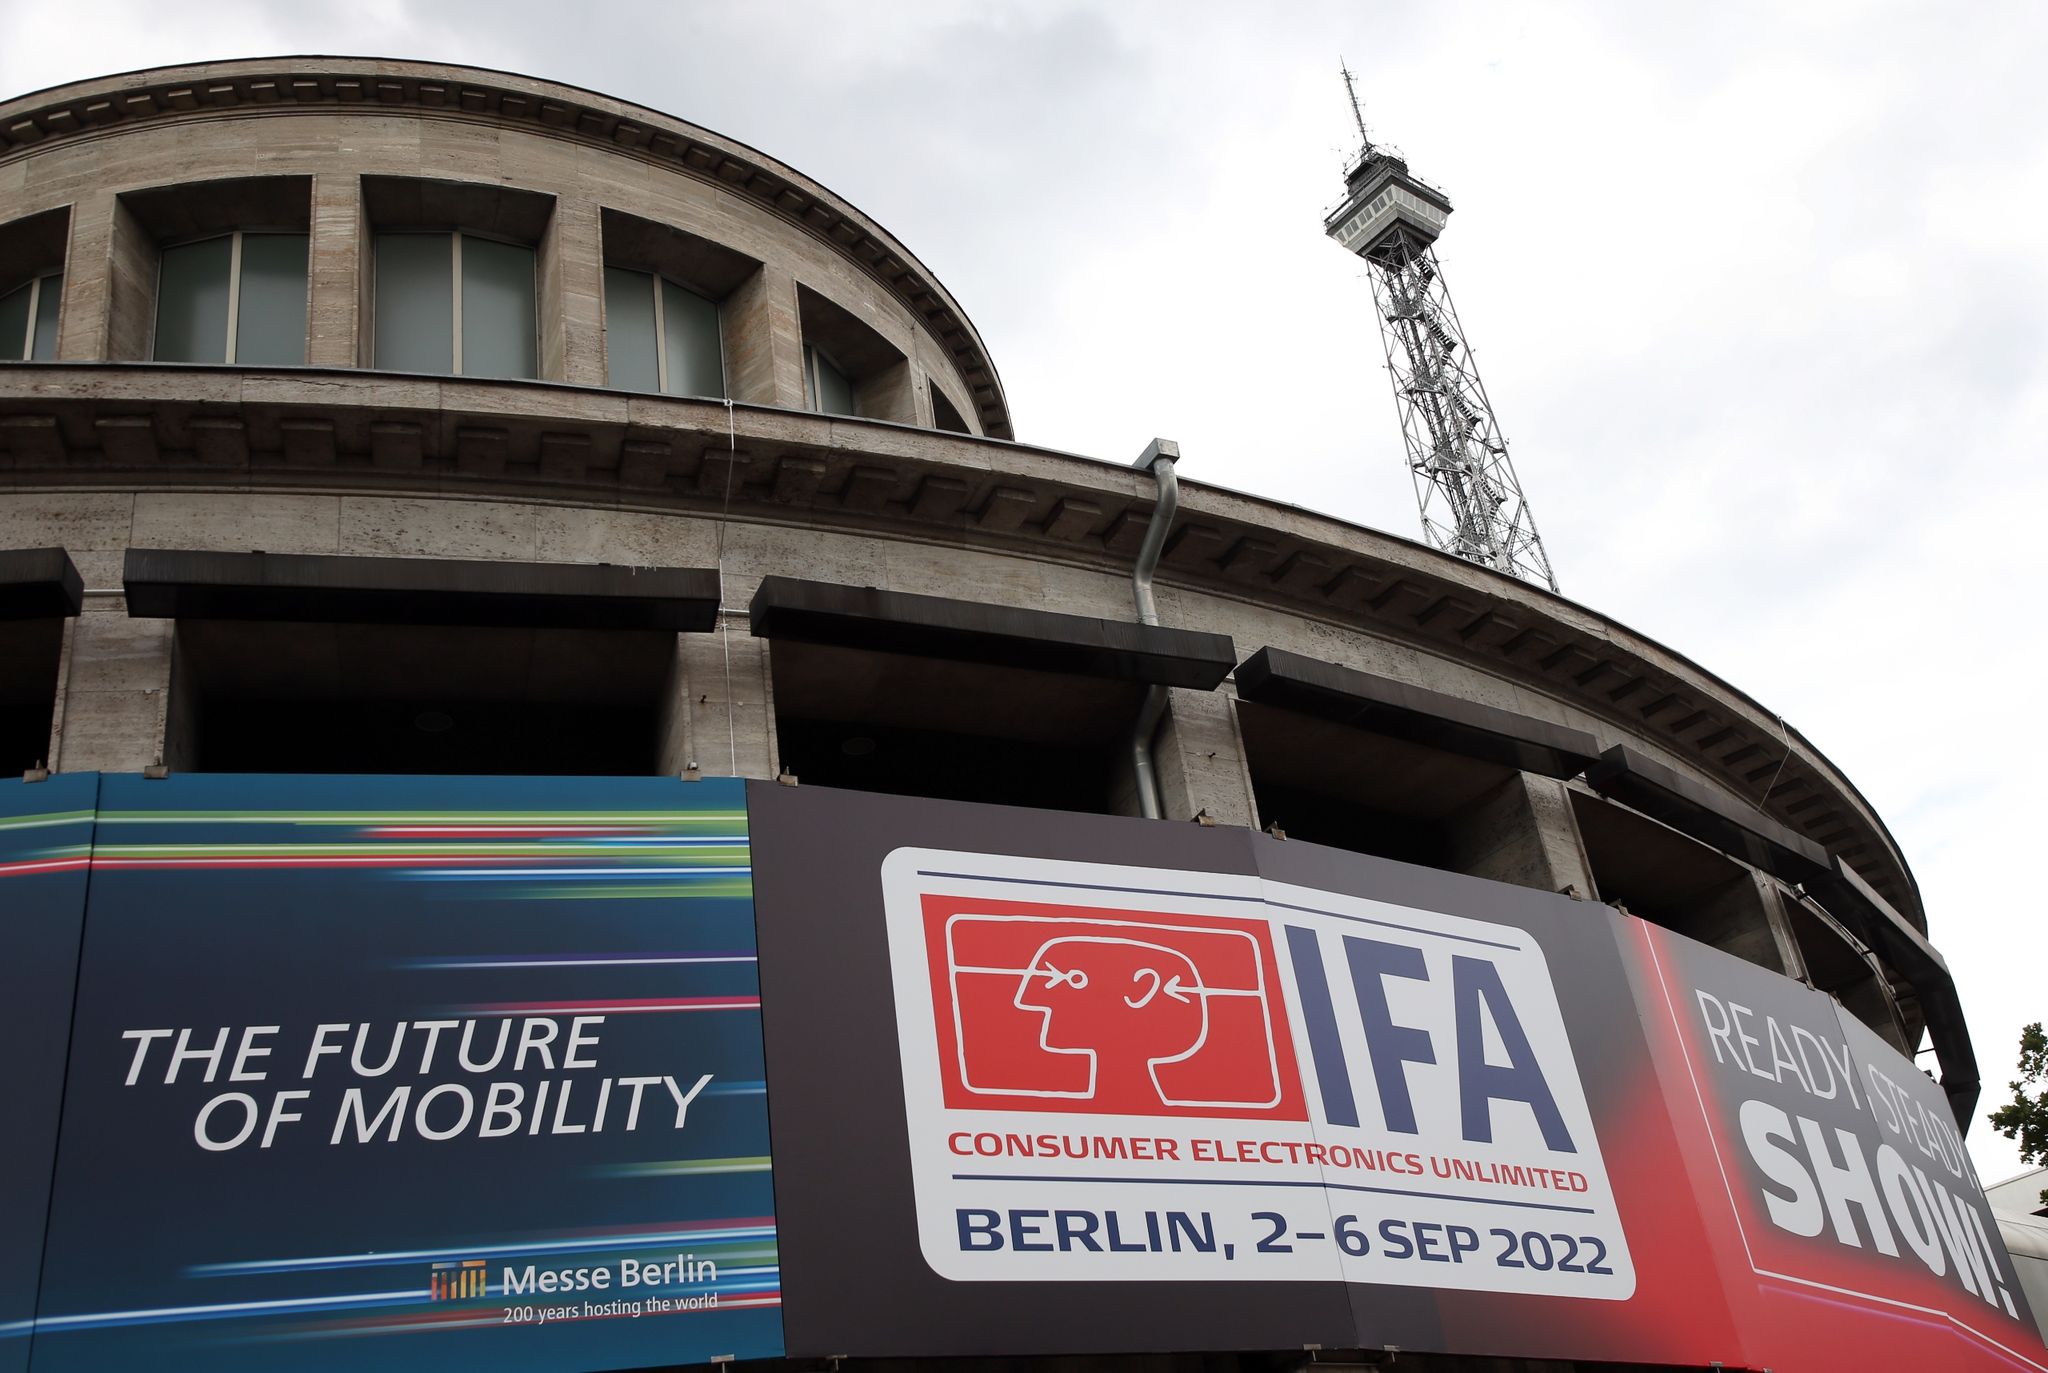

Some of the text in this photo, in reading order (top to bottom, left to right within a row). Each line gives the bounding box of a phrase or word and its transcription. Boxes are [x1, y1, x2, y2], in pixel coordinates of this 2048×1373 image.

[120, 1015, 605, 1086] THE FUTURE
[1284, 924, 1578, 1154] IFA
[194, 1074, 714, 1151] OF MOBILITY
[946, 1131, 1589, 1193] CONSUMER ELECTRONICS UNLIMITED
[955, 1208, 1236, 1261] BERLIN,
[1378, 1218, 1481, 1263] SEP
[1489, 1228, 1614, 1276] 2022
[1739, 1099, 2019, 1320] SHOW!
[503, 1254, 718, 1295] Messe Berlin
[503, 1292, 718, 1325] 200 years hosting the world
